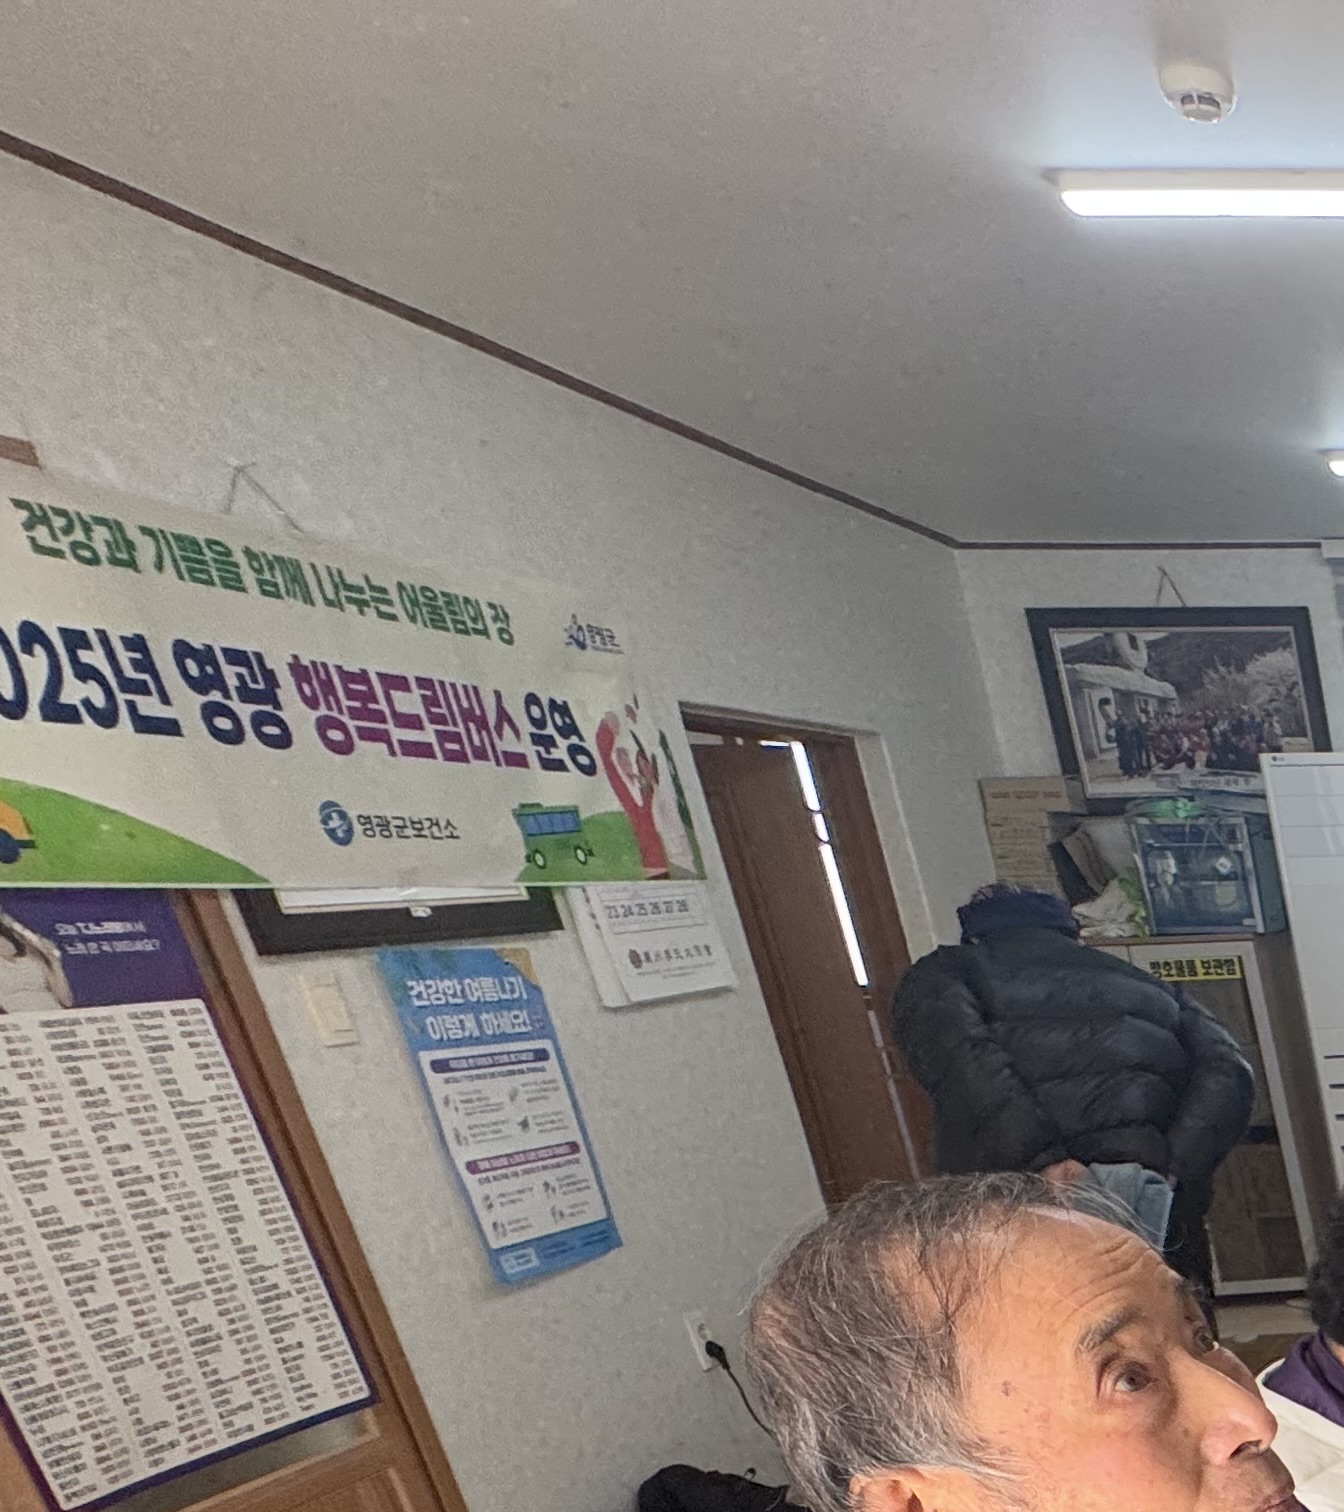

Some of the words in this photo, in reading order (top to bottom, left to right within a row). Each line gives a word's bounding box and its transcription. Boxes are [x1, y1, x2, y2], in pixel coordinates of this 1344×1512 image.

[9, 497, 141, 573] 건강과
[137, 525, 248, 594] 기쁨을
[242, 546, 316, 607] 함께
[309, 562, 399, 622] 나누는
[396, 580, 491, 640] 어울림의
[487, 600, 515, 646] 장
[172, 638, 293, 750] 영광
[286, 653, 530, 770] 행복드림버스
[523, 691, 598, 777] 운영
[357, 813, 461, 841] 영광군보건소
[406, 977, 465, 1007] 건강한
[464, 975, 528, 1002] 여름나기
[425, 1012, 480, 1041] 이렇게
